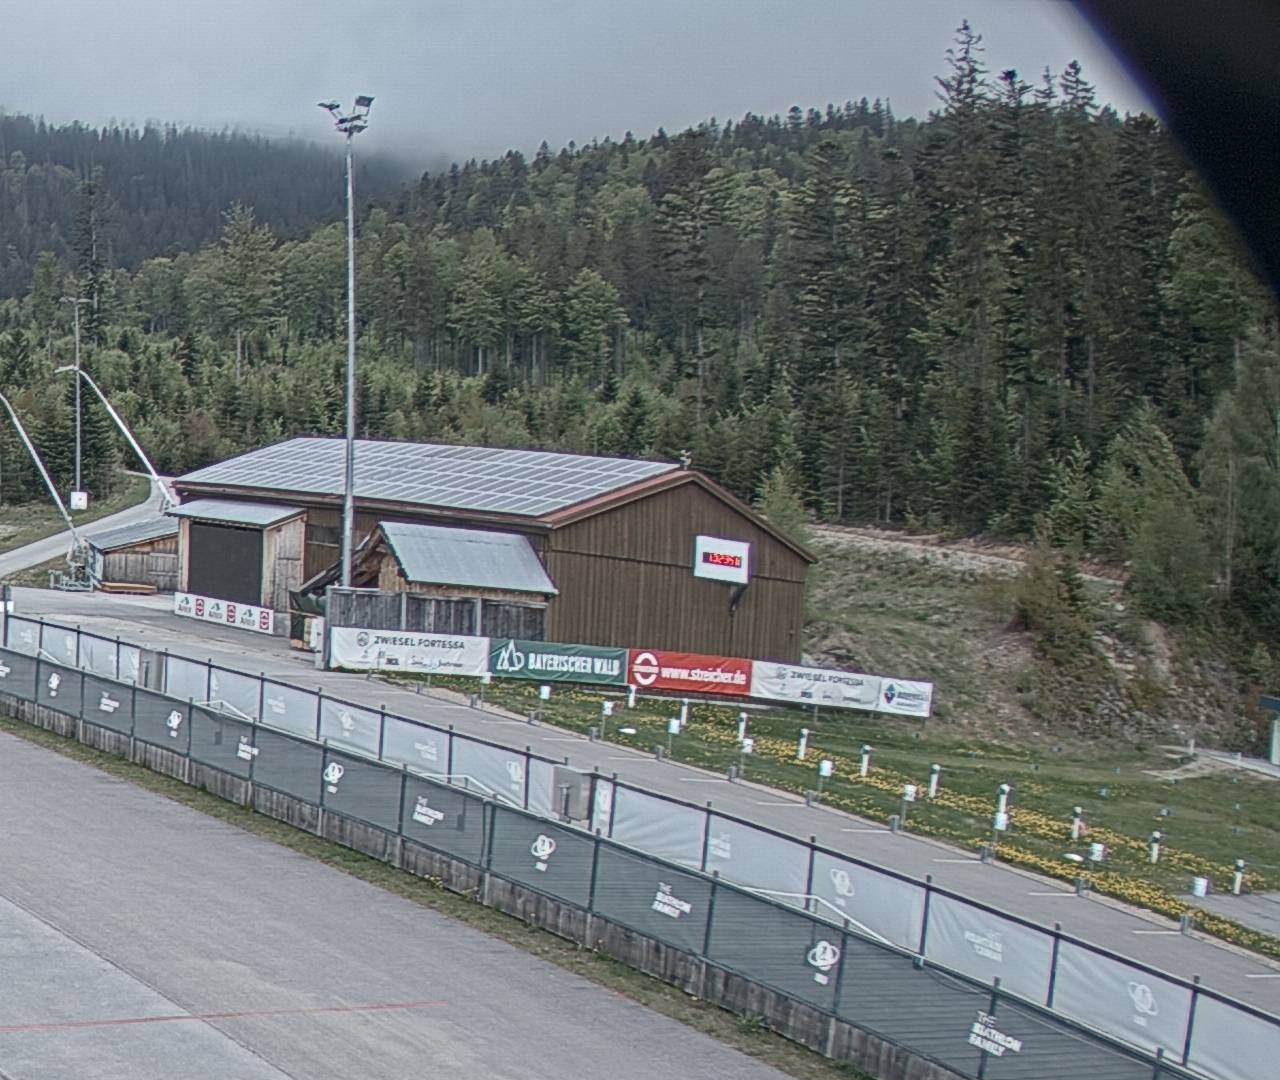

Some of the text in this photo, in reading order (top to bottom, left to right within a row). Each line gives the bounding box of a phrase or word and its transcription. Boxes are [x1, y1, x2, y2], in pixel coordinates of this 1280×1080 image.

[374, 635, 465, 650] ZWIESEL FORTESSA
[527, 652, 592, 674] BAYERISCHER
[593, 658, 620, 676] WALD
[660, 665, 747, 685] www.streicher.de
